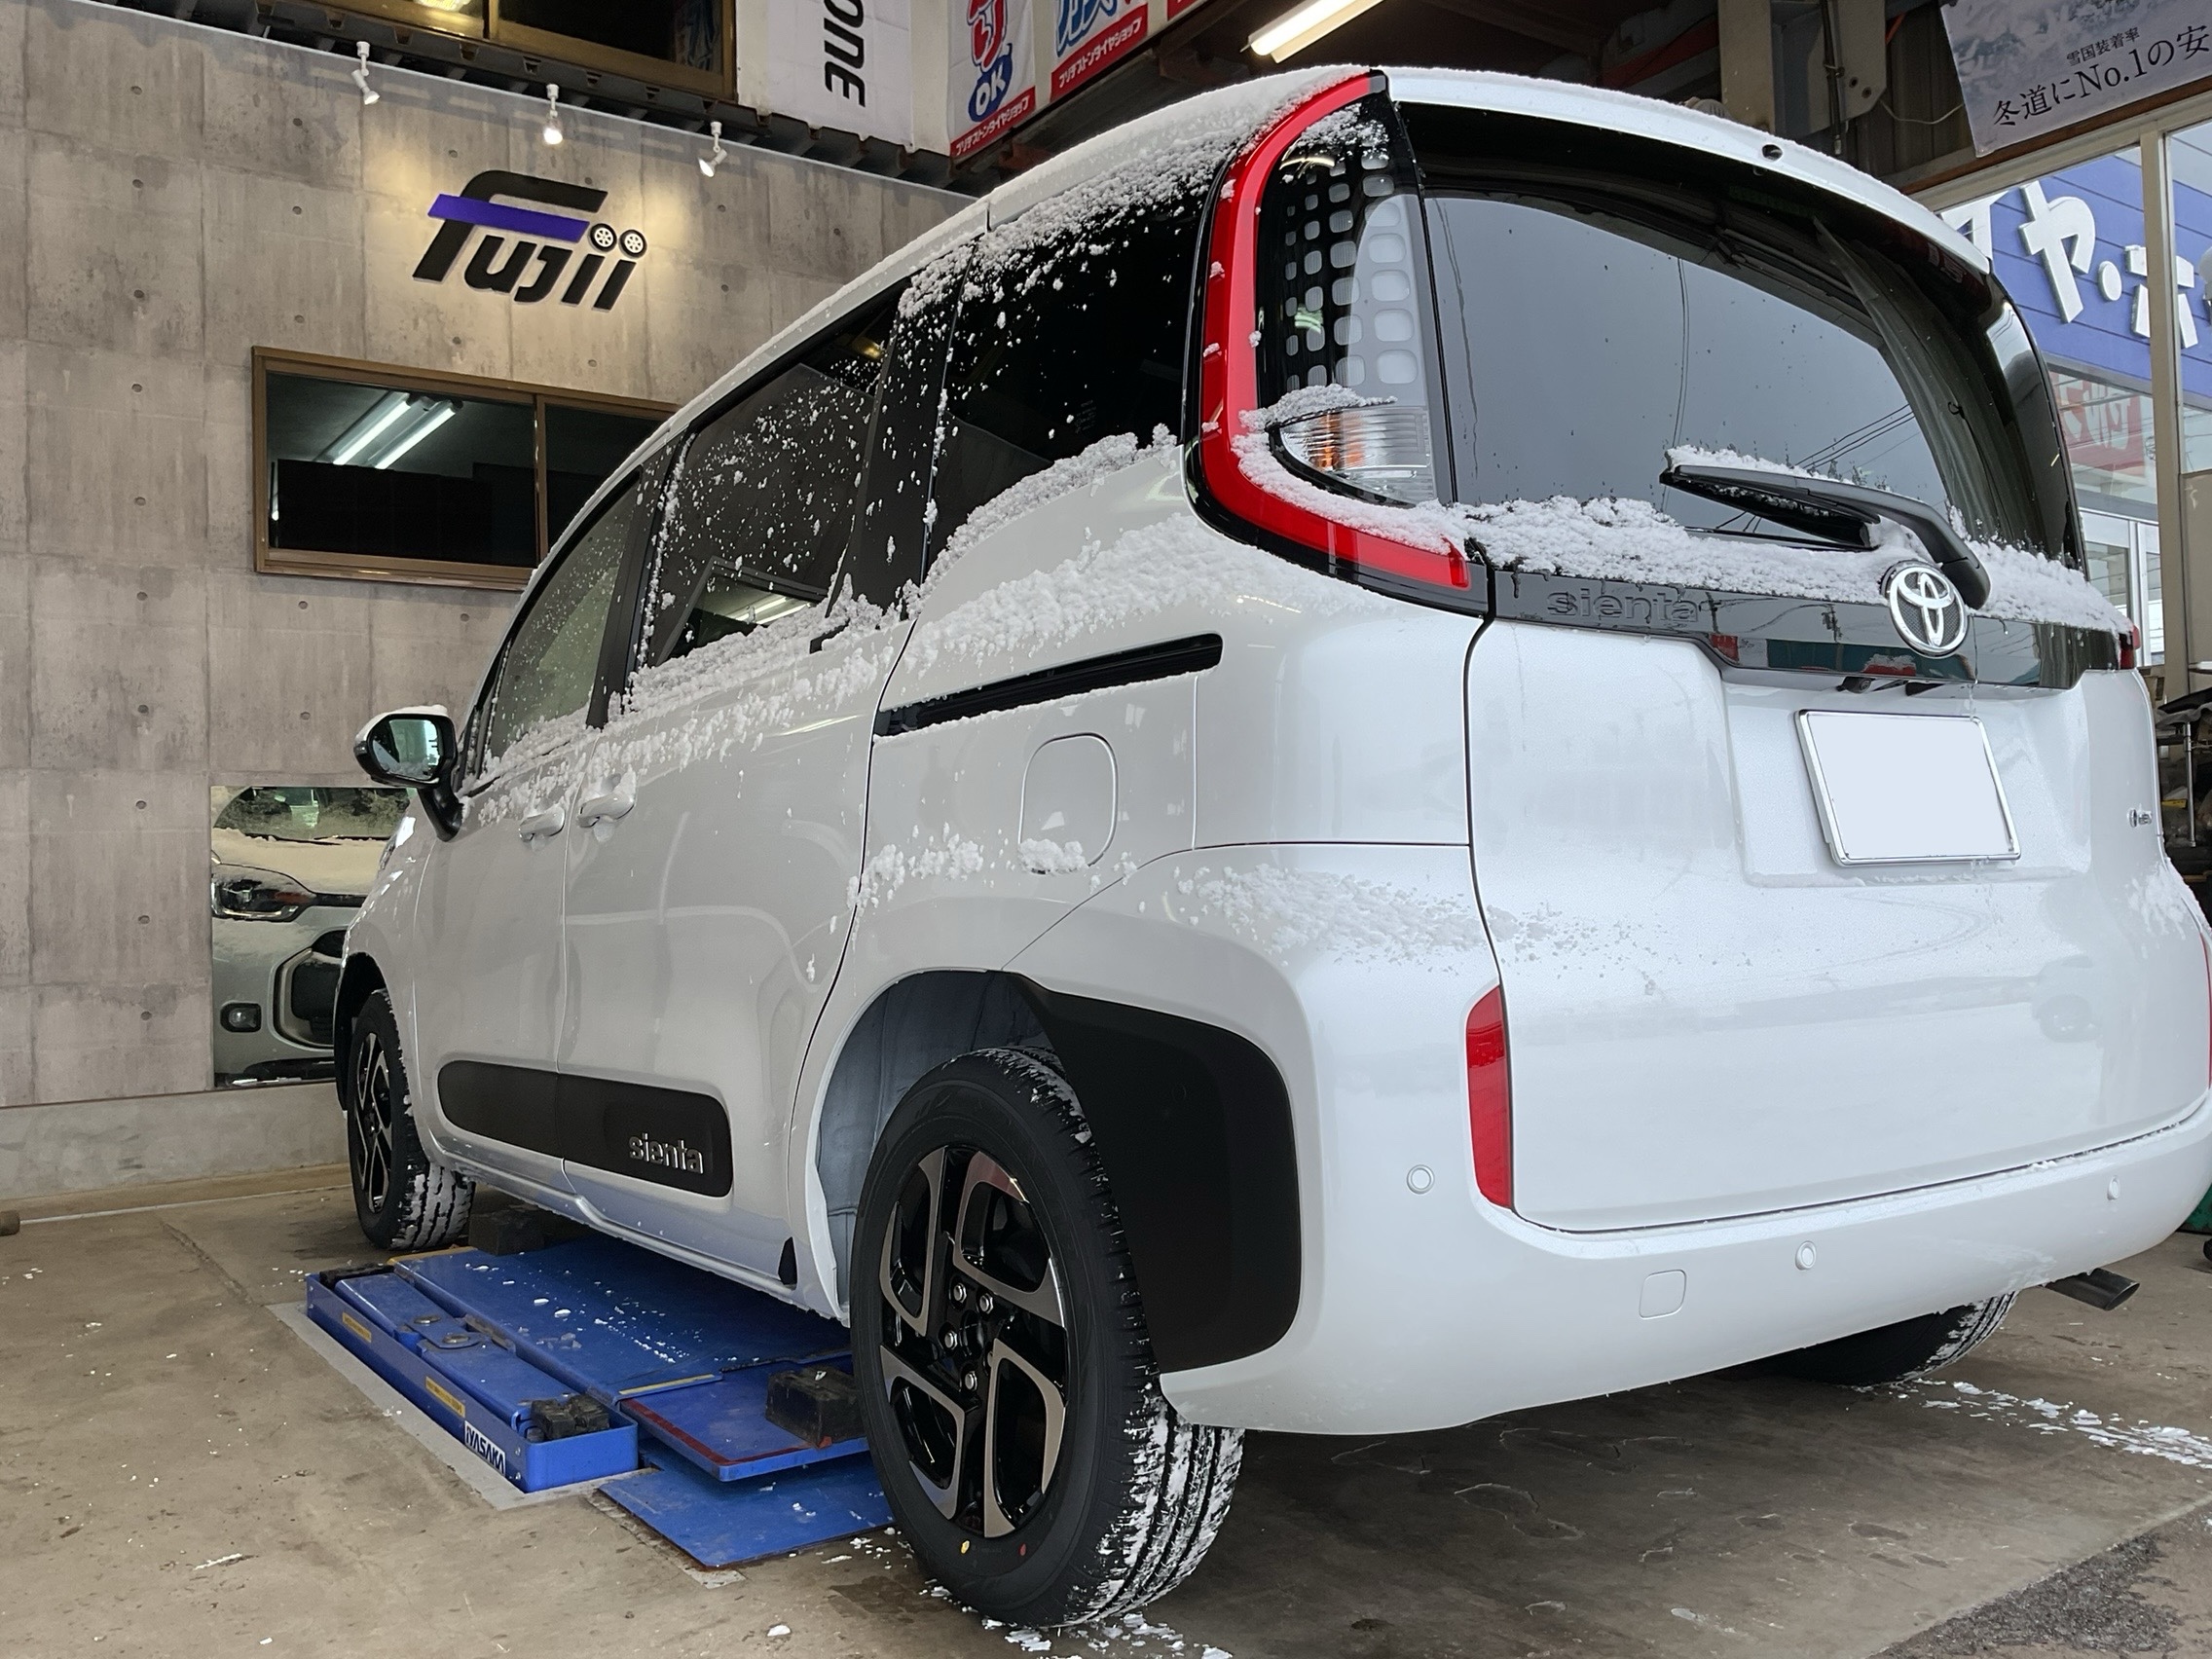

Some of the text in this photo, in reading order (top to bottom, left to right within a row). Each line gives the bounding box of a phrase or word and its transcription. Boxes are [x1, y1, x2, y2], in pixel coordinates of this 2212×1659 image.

[2066, 27, 2141, 66] 雪国装着率
[976, 62, 1006, 116] OK
[1547, 588, 1698, 623] sienta
[629, 1132, 703, 1174] sienta
